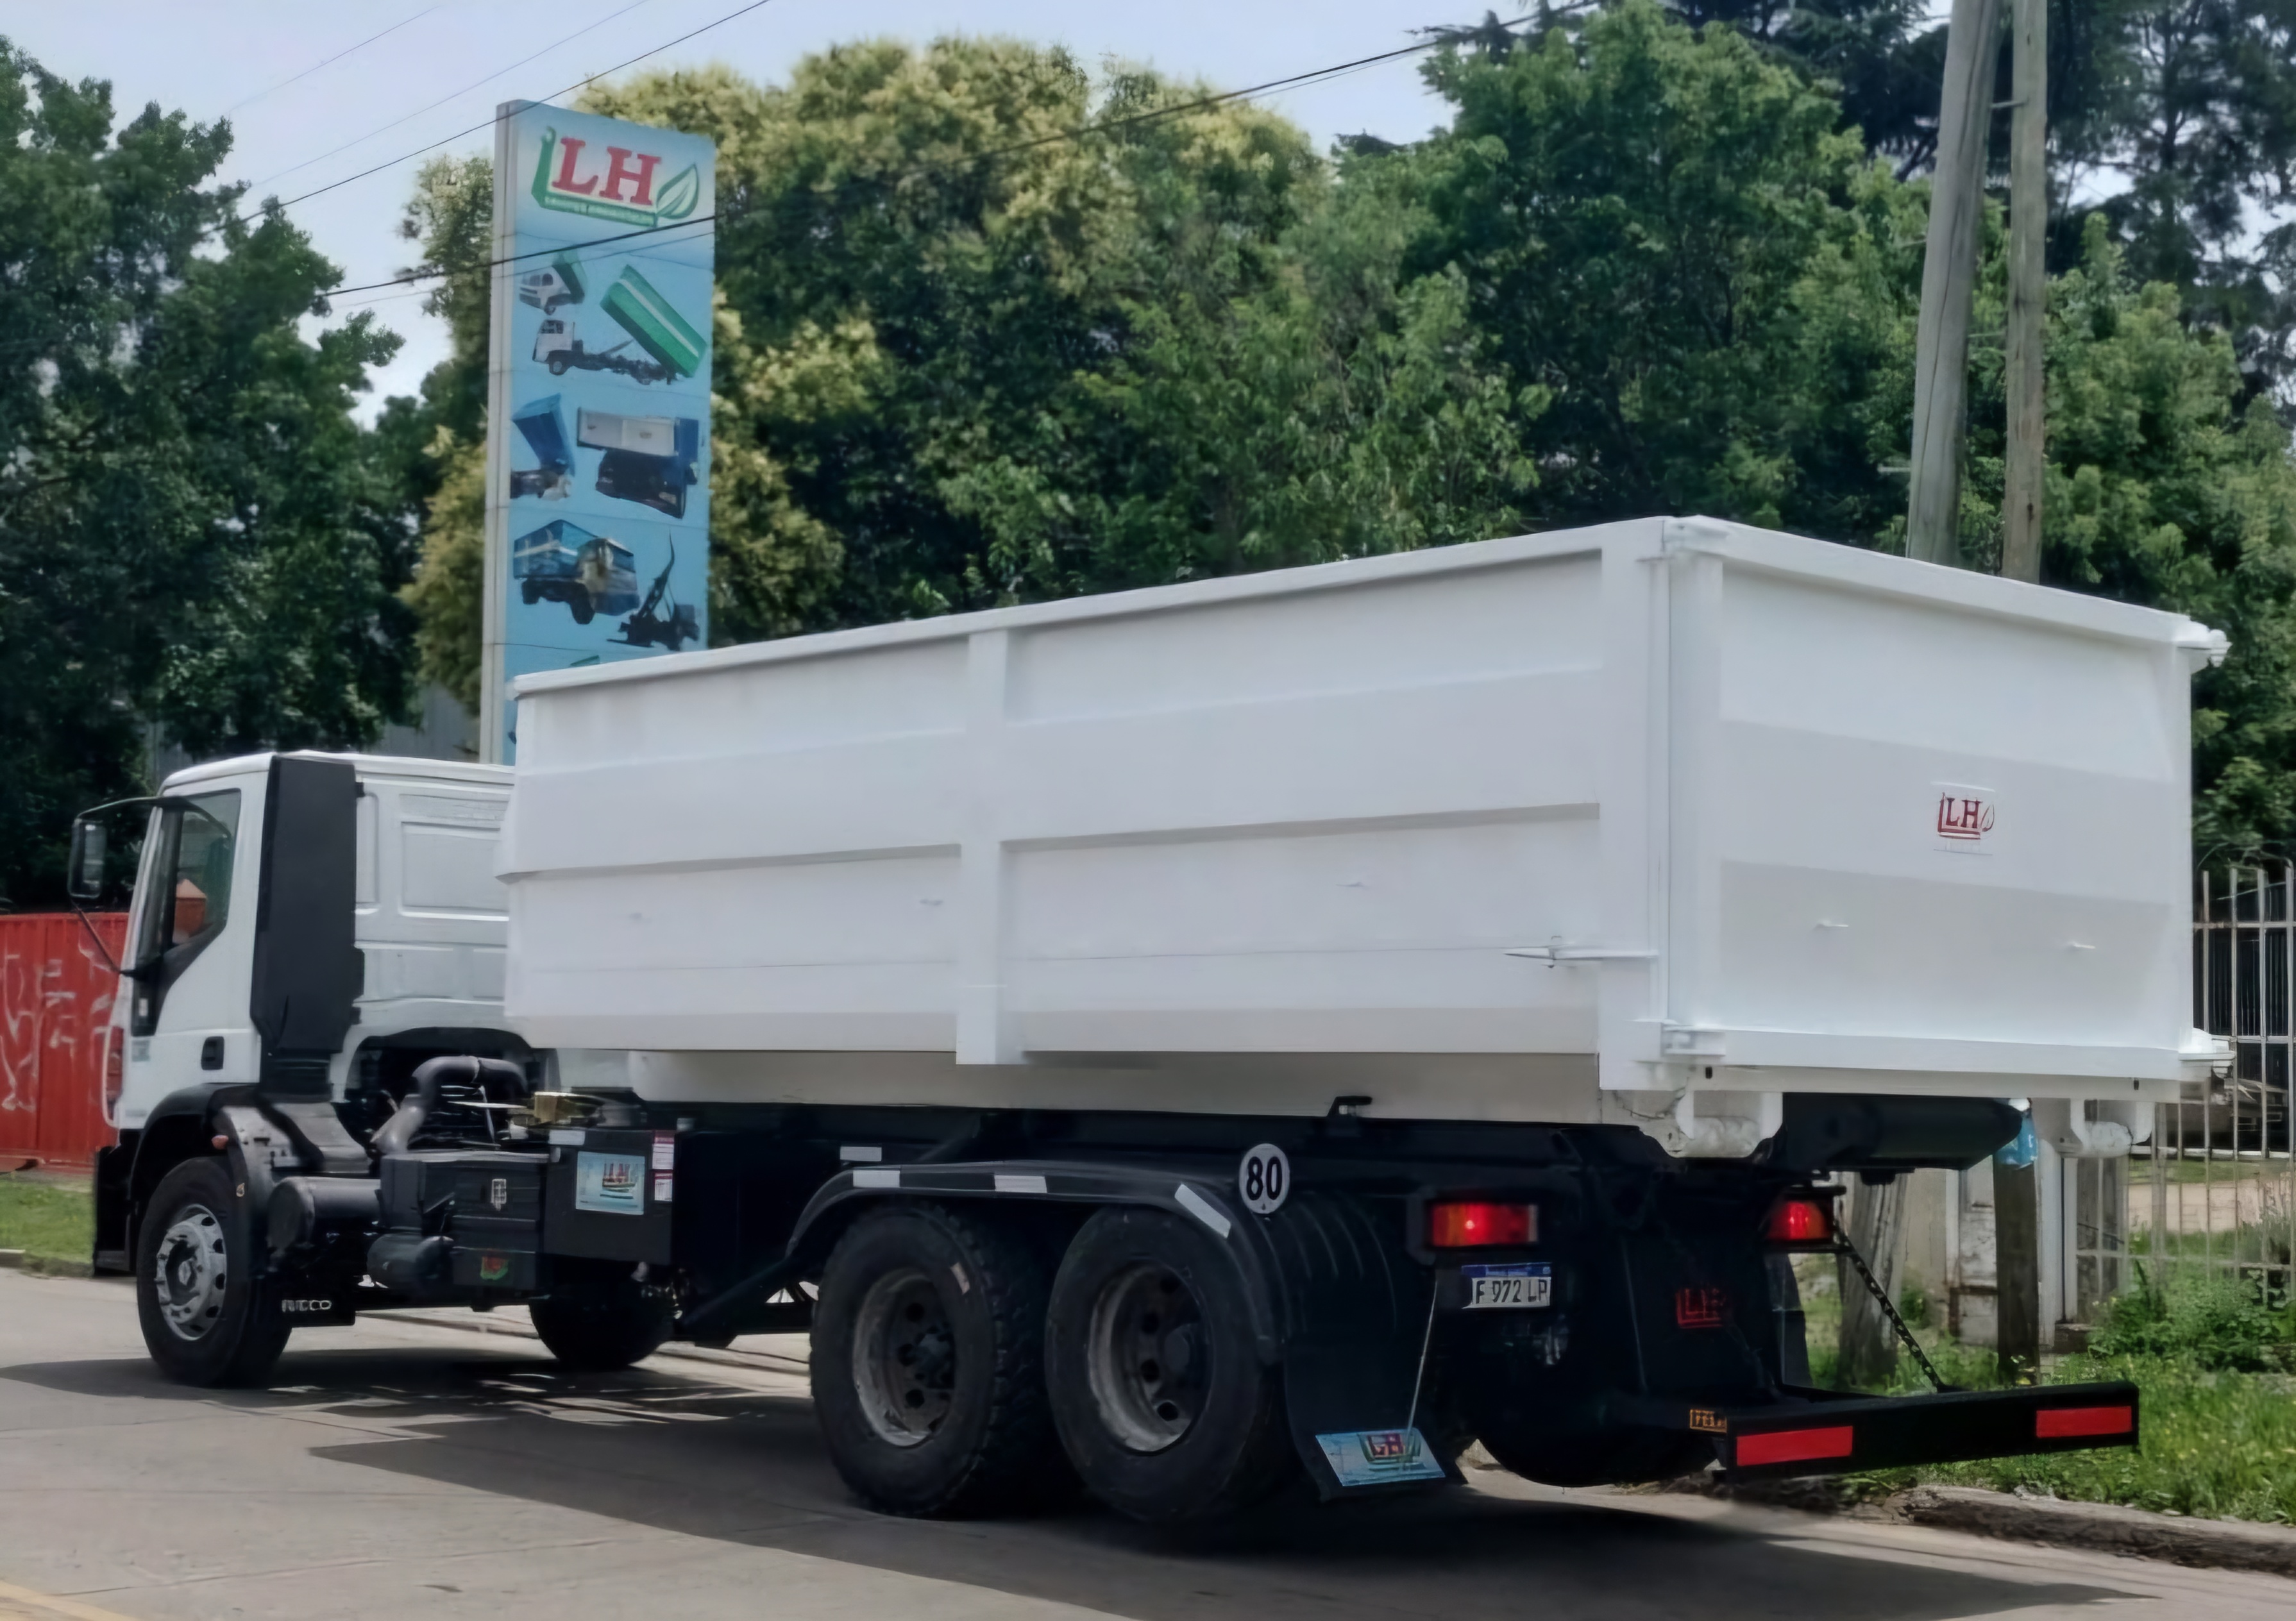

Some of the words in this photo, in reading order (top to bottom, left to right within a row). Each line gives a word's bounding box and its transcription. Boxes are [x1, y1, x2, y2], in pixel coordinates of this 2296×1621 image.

[552, 137, 662, 206] LH
[1945, 796, 1983, 829] LH
[1246, 1156, 1282, 1200] 80
[1492, 1280, 1521, 1303] 972
